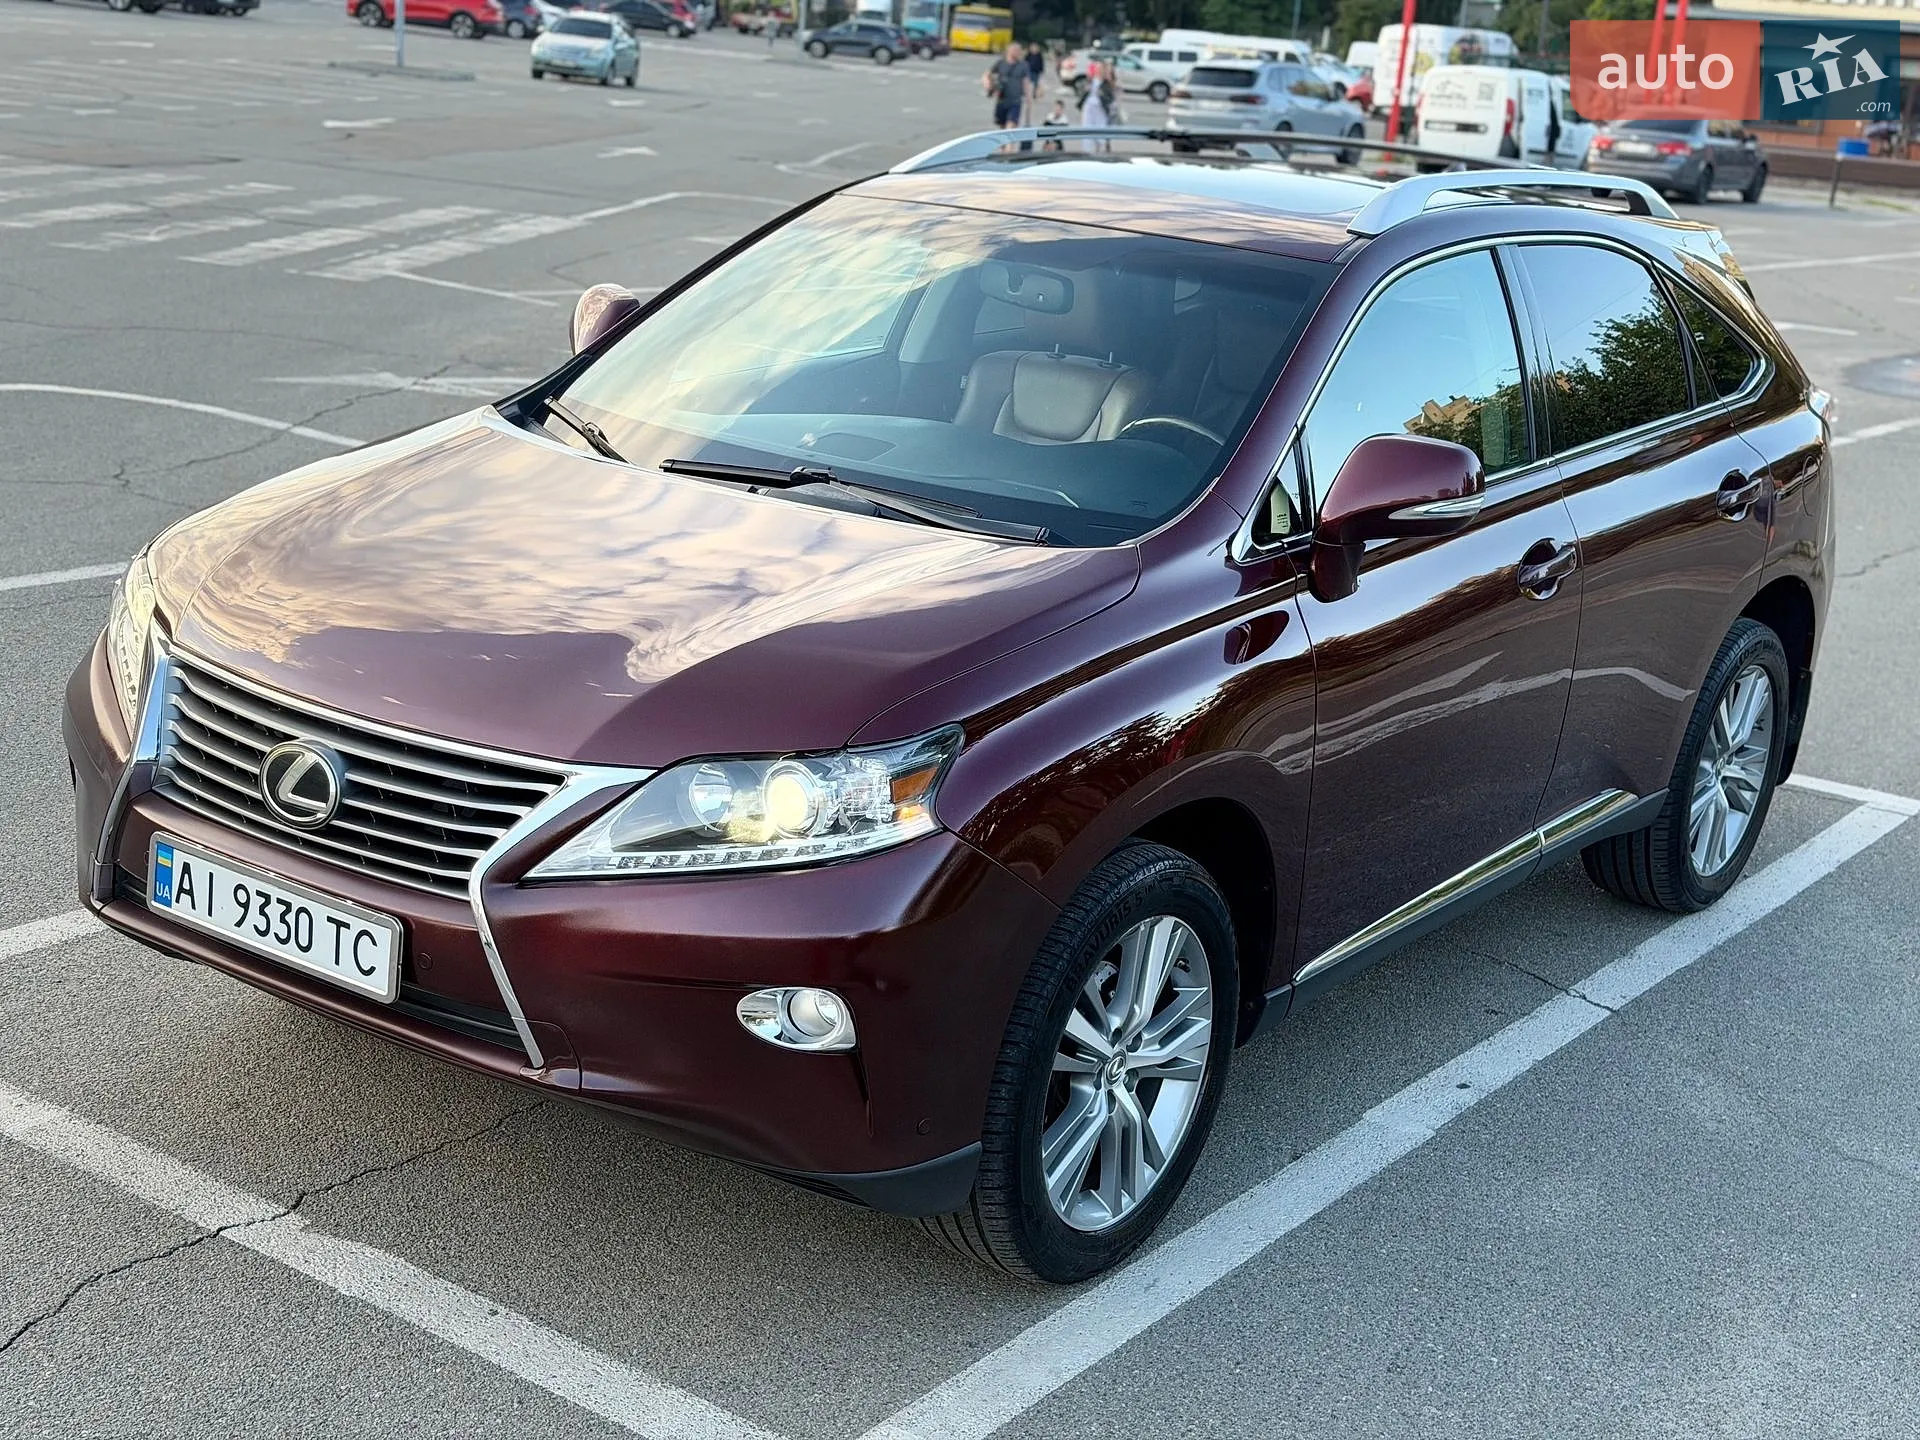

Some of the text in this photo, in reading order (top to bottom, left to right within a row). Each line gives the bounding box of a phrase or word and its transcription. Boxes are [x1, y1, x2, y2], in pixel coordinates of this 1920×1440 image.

[156, 880, 171, 900] UA
[175, 861, 378, 977] AI 9330 TC
